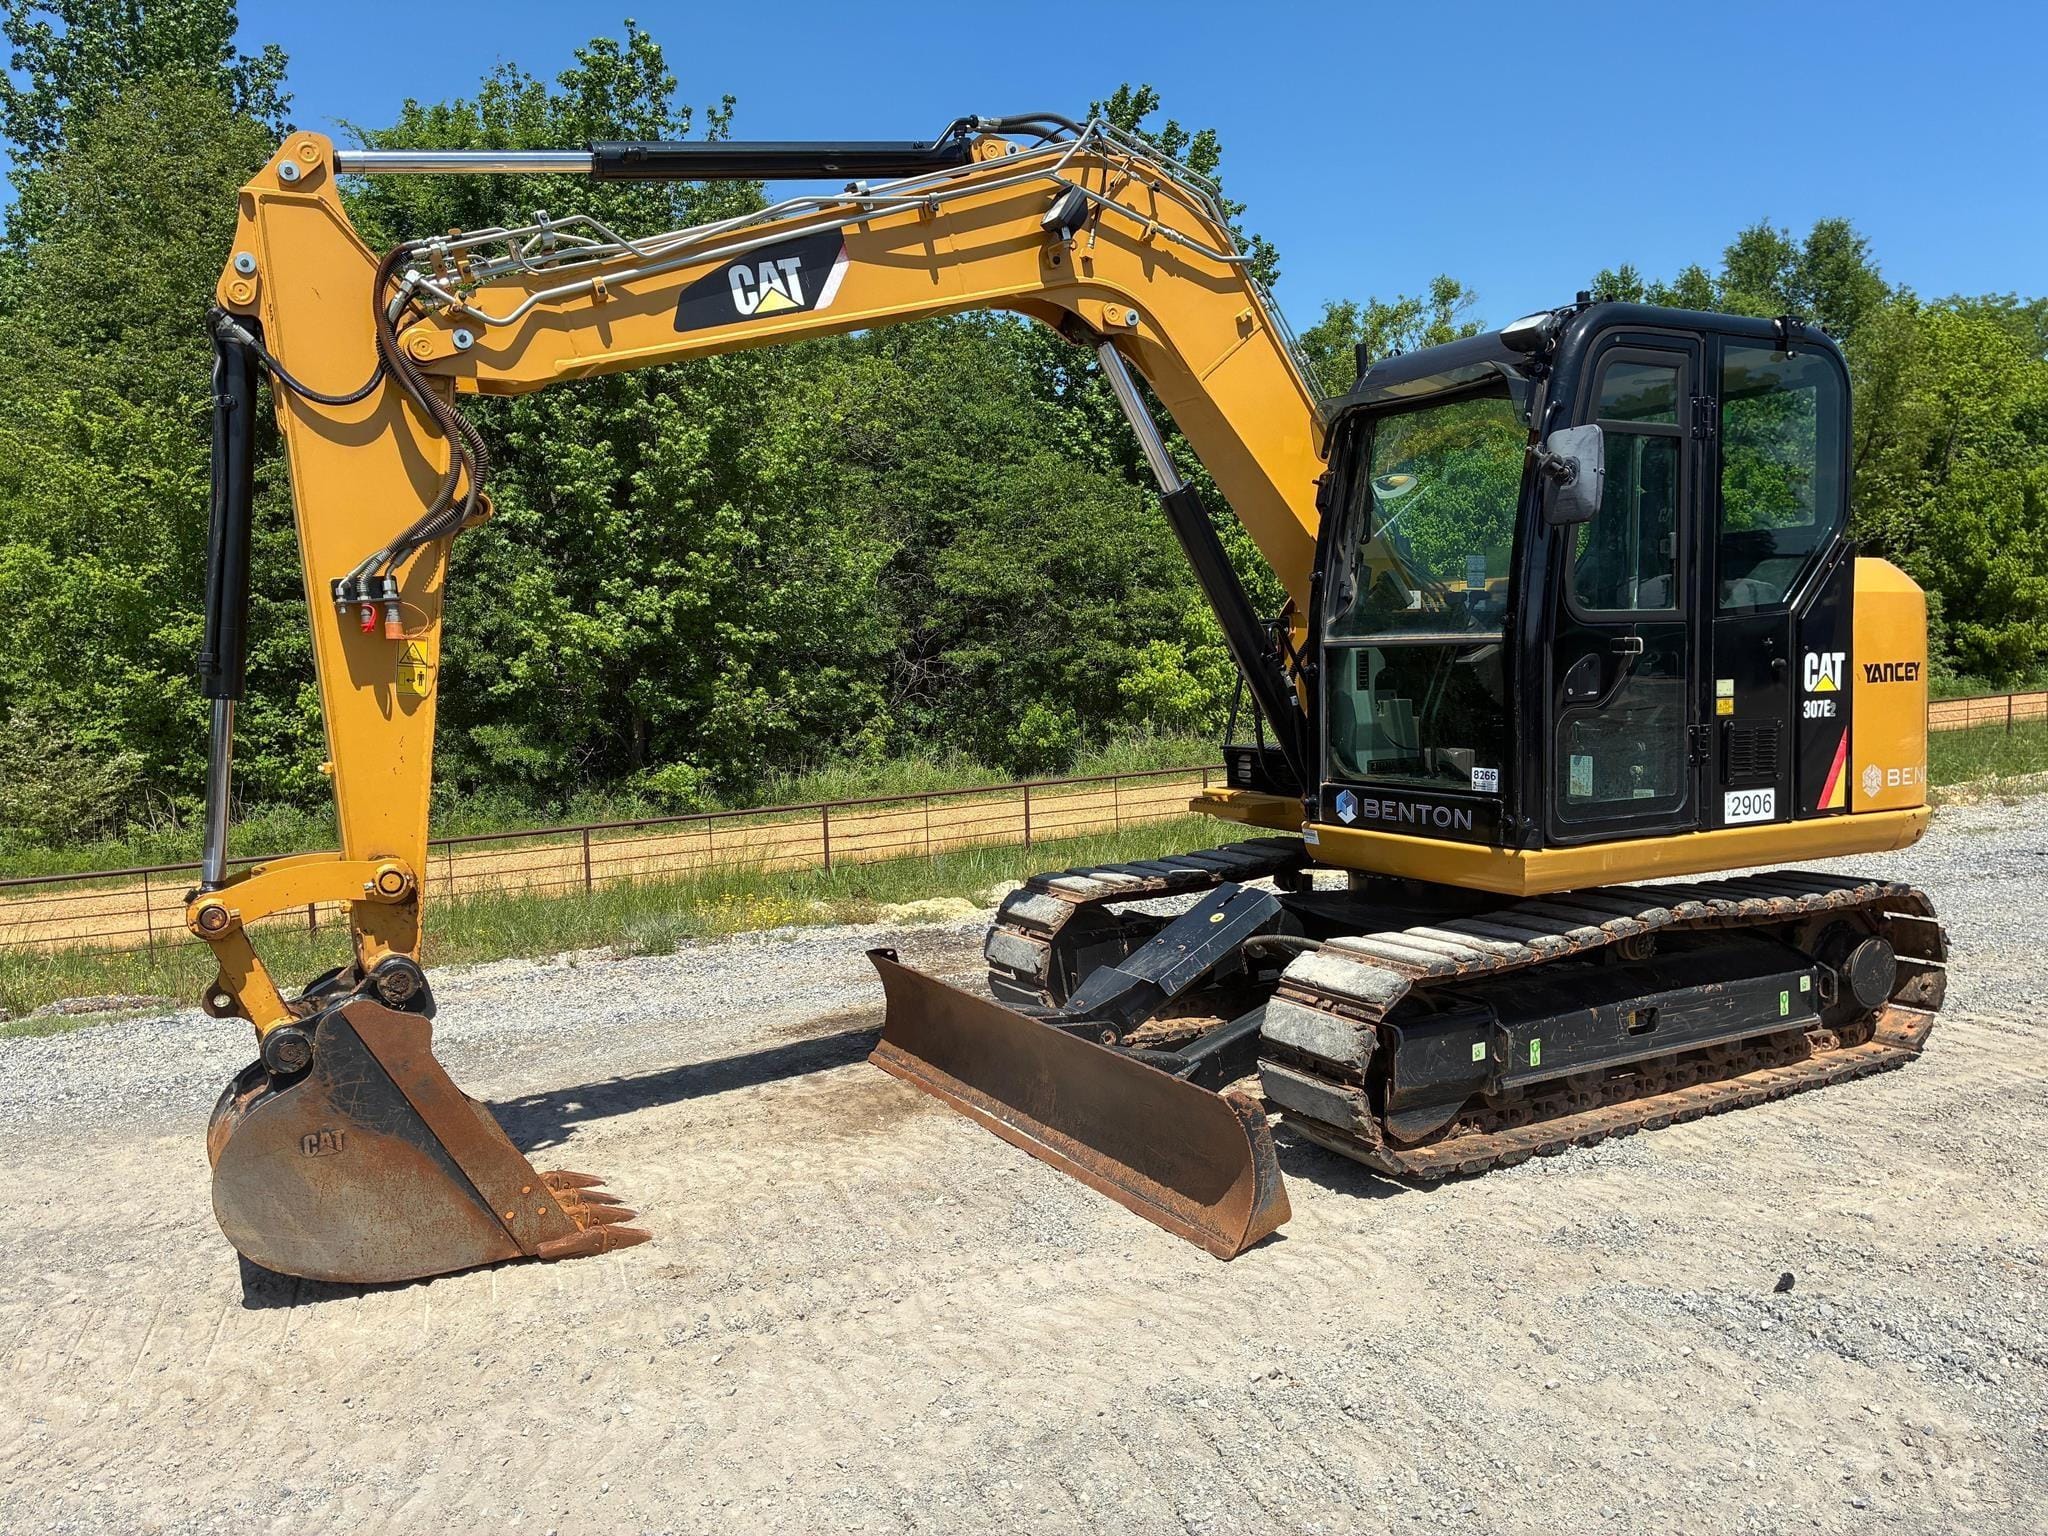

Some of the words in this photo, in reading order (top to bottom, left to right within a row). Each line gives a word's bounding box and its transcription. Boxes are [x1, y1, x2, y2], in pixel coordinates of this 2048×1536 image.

[728, 257, 805, 315] CAT
[1803, 652, 1846, 692] CAT
[1863, 662, 1921, 684] YANCEY
[1802, 699, 1836, 719] 307E2
[1473, 770, 1497, 781] 8266
[1887, 765, 1926, 787] BEN
[1363, 798, 1473, 831] BENTON
[1731, 793, 1772, 817] 2906
[302, 1128, 345, 1158] CAT
